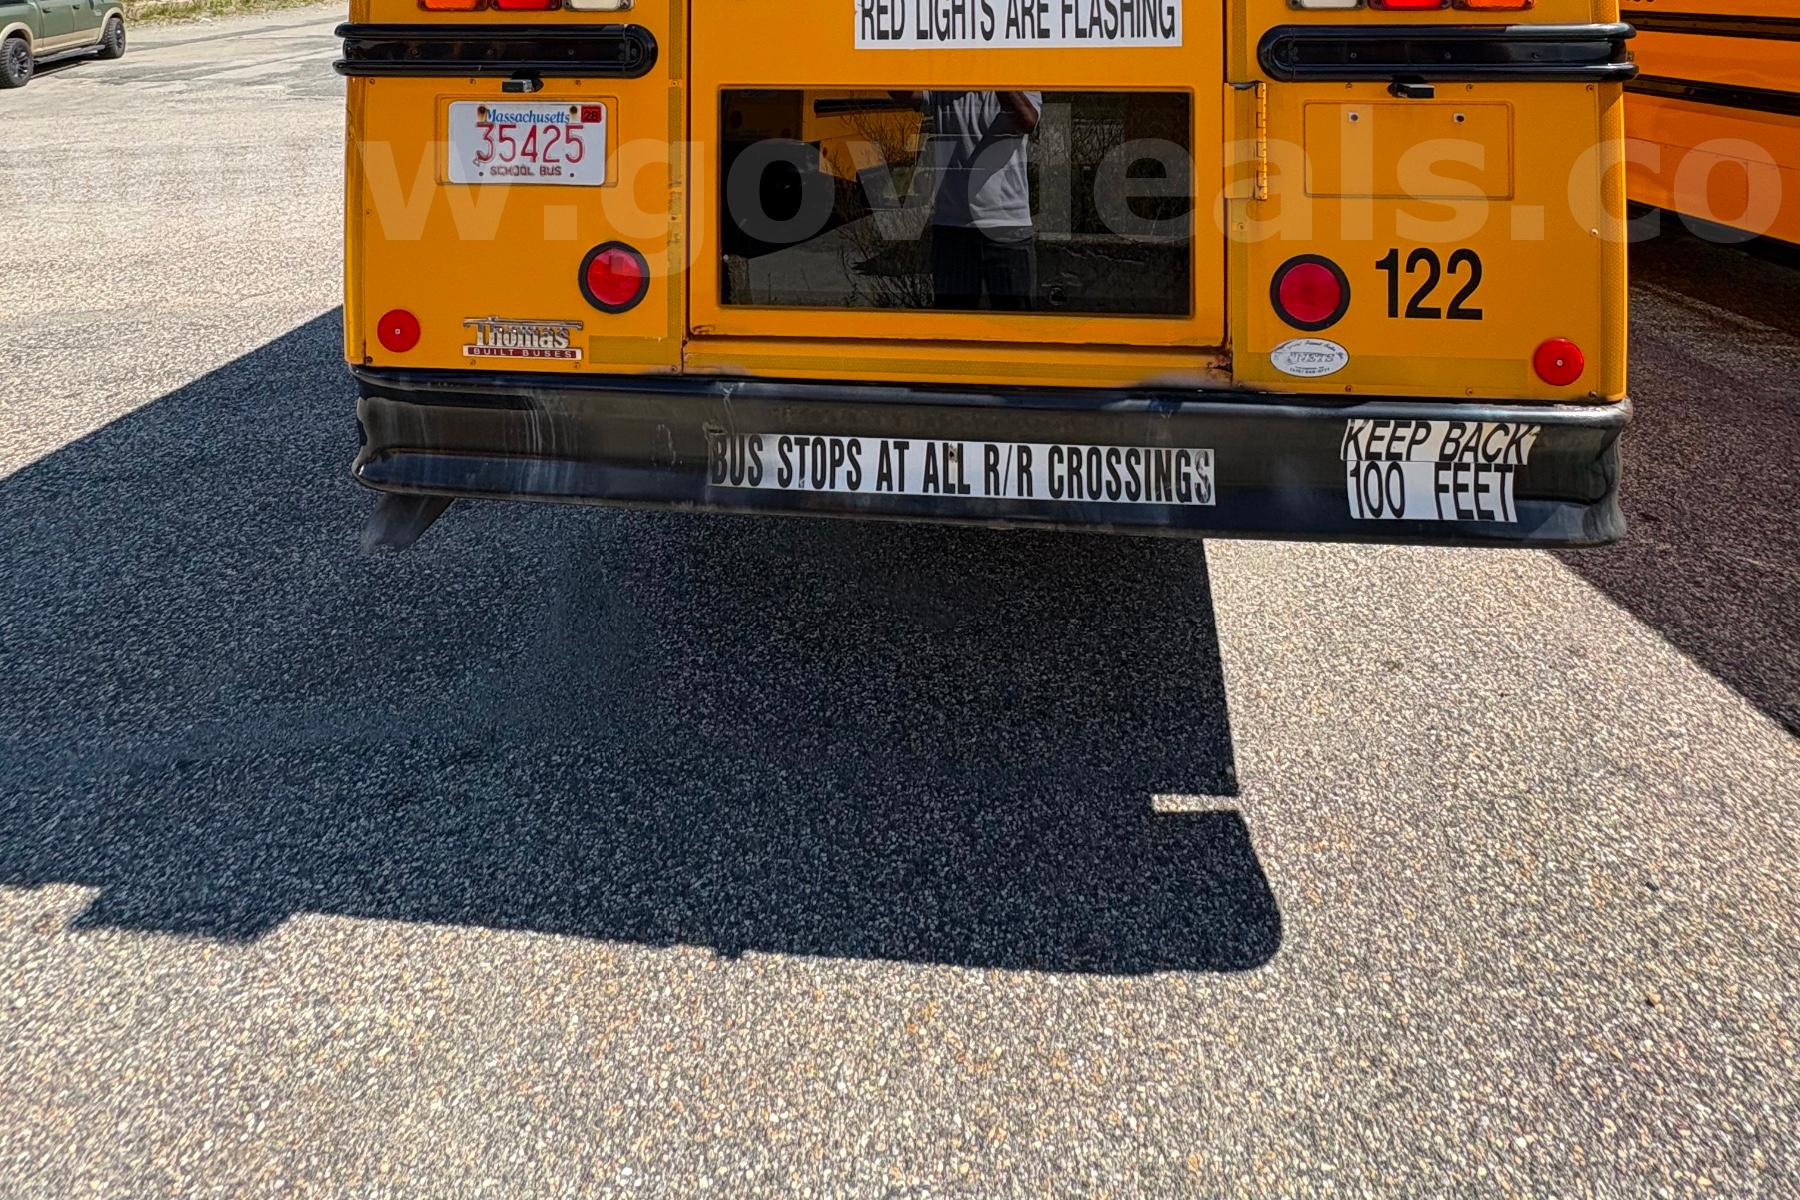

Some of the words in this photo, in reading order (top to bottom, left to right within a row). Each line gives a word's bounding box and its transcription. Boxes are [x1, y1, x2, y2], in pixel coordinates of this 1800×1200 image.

[486, 108, 570, 124] Massachusetts
[583, 109, 599, 122] 28
[475, 122, 585, 164] 35425
[490, 165, 534, 176] SCHOOL
[539, 166, 562, 176] BUS
[1375, 248, 1483, 320] 122
[463, 316, 583, 348] Thomas
[473, 348, 516, 356] BUILT
[522, 349, 573, 358] BUSES
[1343, 419, 1432, 460] KEEP
[1438, 422, 1537, 465] BACK
[711, 434, 763, 487] BUS
[777, 435, 862, 492] STOPS
[876, 441, 909, 492] AT
[922, 442, 971, 495] ALL
[983, 445, 1033, 497] R/R
[1048, 446, 1212, 504] CROSSINGS
[1349, 460, 1406, 518] 100
[1434, 462, 1514, 522] FEET
